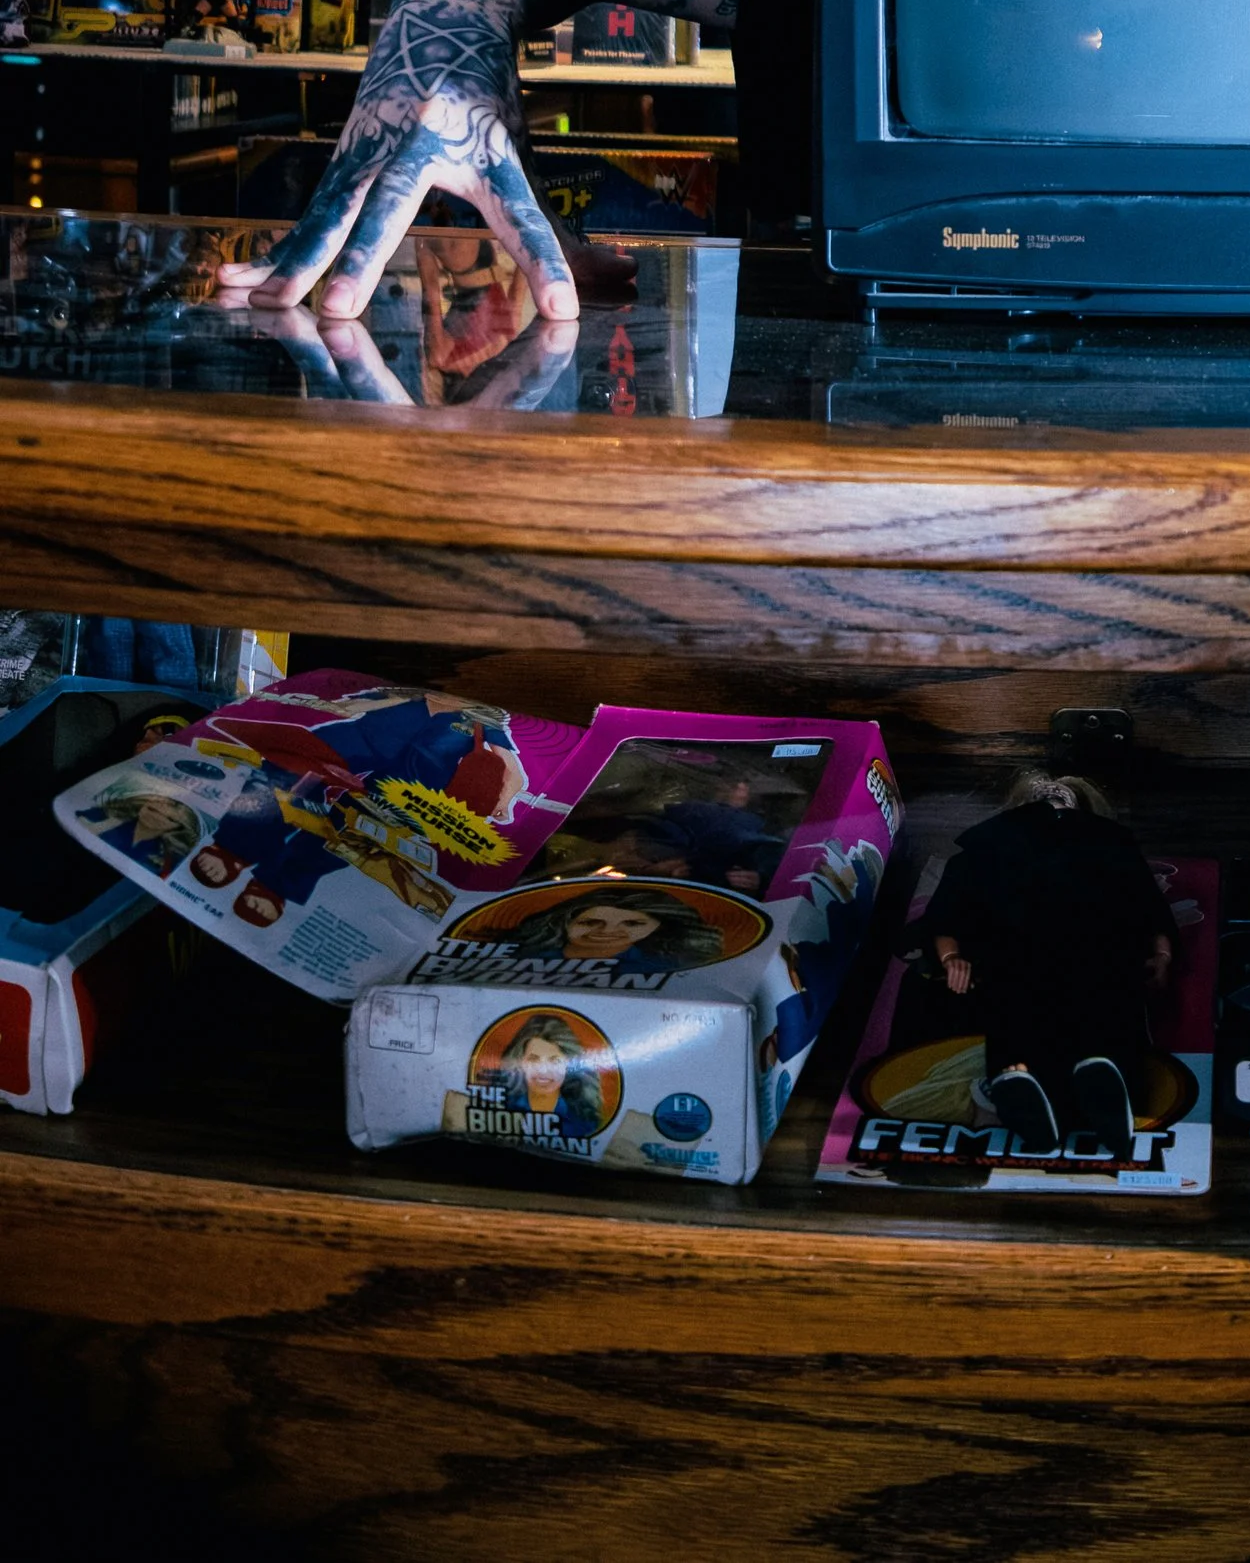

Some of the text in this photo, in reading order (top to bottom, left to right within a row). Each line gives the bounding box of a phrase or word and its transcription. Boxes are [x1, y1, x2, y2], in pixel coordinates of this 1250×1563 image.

[942, 226, 1020, 250] Symphonic
[1036, 235, 1085, 243] TELEVISION
[401, 789, 496, 850] MISSION
[439, 802, 471, 823] NEW
[404, 802, 483, 854] PURSE
[438, 937, 521, 958] THE
[417, 954, 620, 977] BIONIC
[468, 1085, 508, 1109] THE
[468, 1107, 561, 1136] BIONIC
